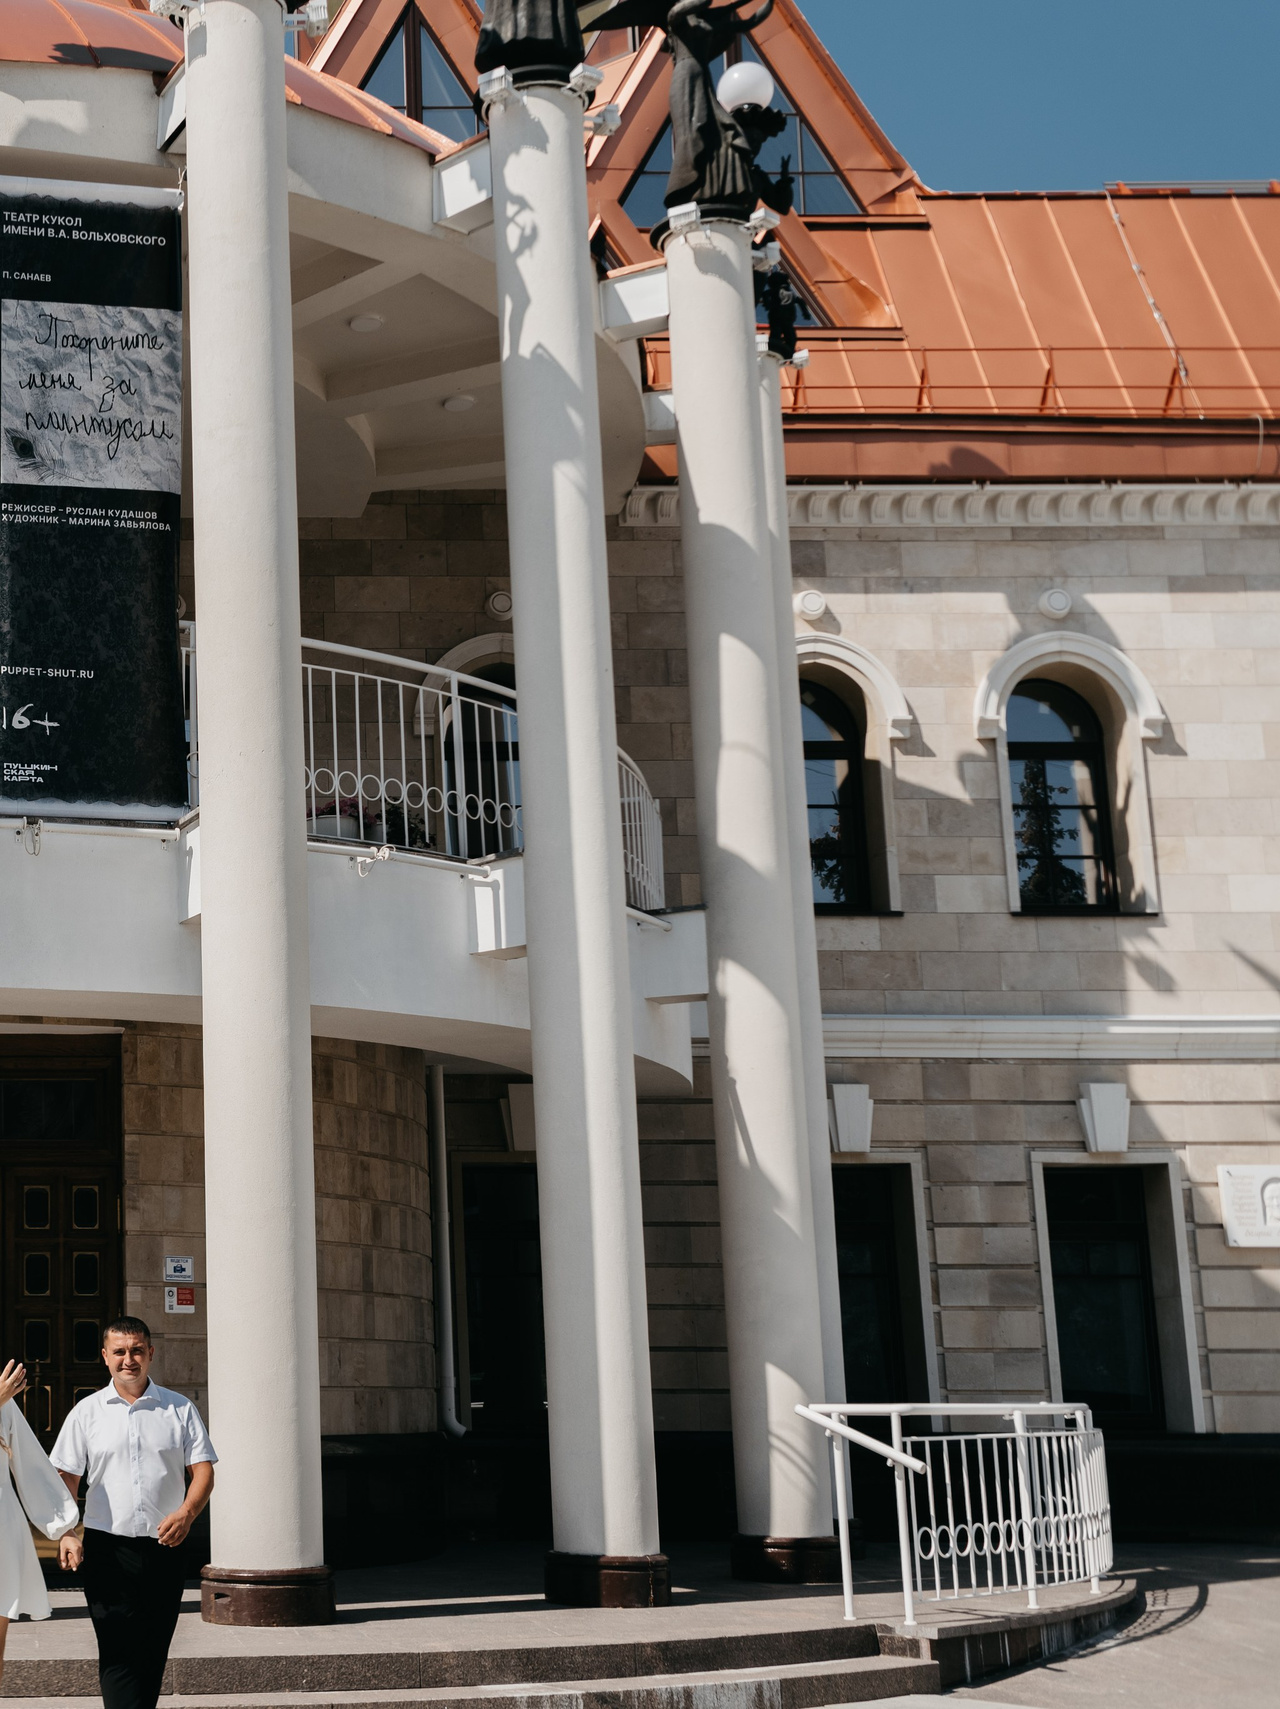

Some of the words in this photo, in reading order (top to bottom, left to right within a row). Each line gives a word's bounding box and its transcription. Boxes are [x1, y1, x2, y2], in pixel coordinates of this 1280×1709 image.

[3, 211, 40, 223] ТЕАТР
[42, 215, 82, 227] КУКОЛ
[3, 224, 45, 237] ИМЕНИ
[47, 228, 70, 239] В.А.
[72, 230, 166, 246] ВОЛЬХОВСКОГО
[2, 271, 12, 279] П.
[13, 272, 52, 282] САНАЕВ
[35, 313, 164, 381] Похороните
[19, 373, 82, 390] меня
[99, 376, 137, 413] за
[25, 411, 174, 460] плинтусом
[1, 503, 56, 513] РЕЖИССЕР
[65, 507, 106, 517] РУСЛАН
[107, 509, 158, 519] КУДАШОВ
[1, 513, 59, 524] ХУДОЖНИК
[68, 517, 111, 527] МАРИНА
[113, 519, 171, 531] ЗАВЬЯЛОВА
[0, 665, 94, 679] PUPPET-SHUT.RU
[2, 703, 60, 736] 16+
[3, 762, 58, 771] ПУШКИН
[3, 775, 44, 783] КАРТА
